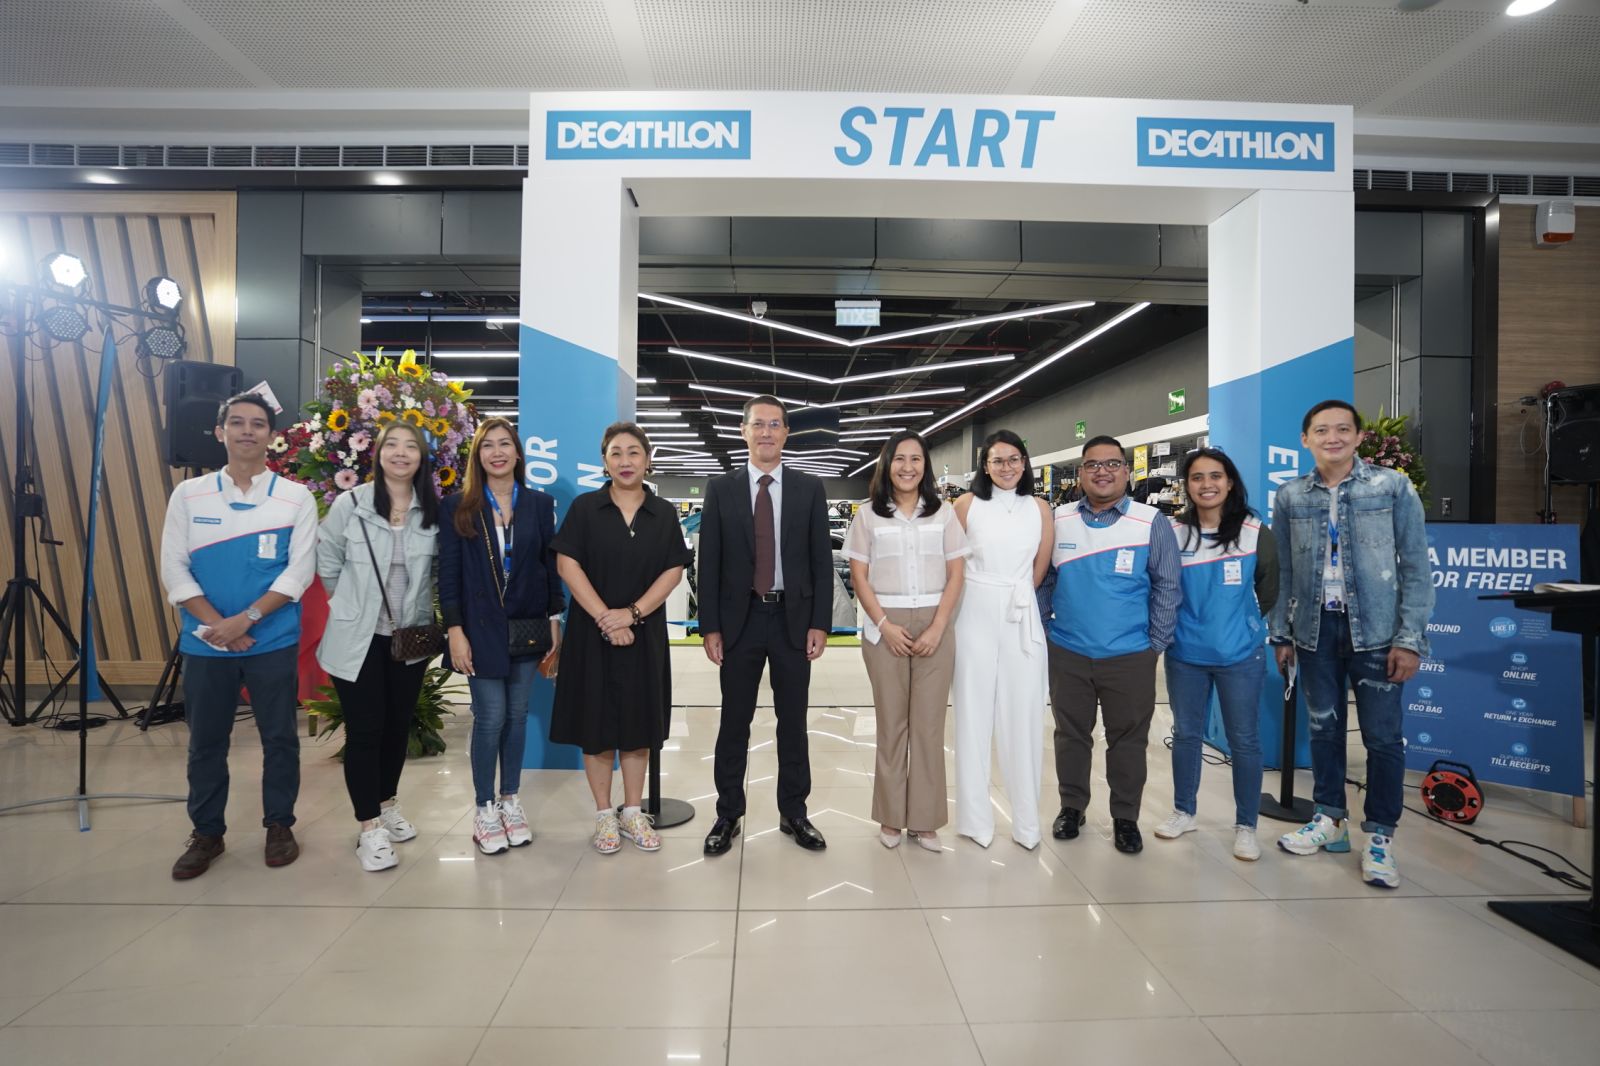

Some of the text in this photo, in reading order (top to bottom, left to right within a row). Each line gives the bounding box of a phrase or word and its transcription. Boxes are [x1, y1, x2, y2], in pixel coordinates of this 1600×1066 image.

[557, 120, 740, 150] DECATHLON
[834, 106, 1056, 169] START
[1148, 128, 1324, 161] DECATHLON
[525, 436, 558, 492] OR
[1447, 547, 1567, 569] MEMBER
[1431, 570, 1533, 591] OR FREE!
[1419, 662, 1445, 673] ENTS
[1502, 670, 1537, 681] ONLINE
[1408, 703, 1443, 714] ECO BAG
[1483, 712, 1511, 721] RETURN
[1518, 716, 1557, 727] EXCHANGE
[1491, 757, 1508, 767] TILL
[1509, 760, 1551, 773] RECEIPTS
